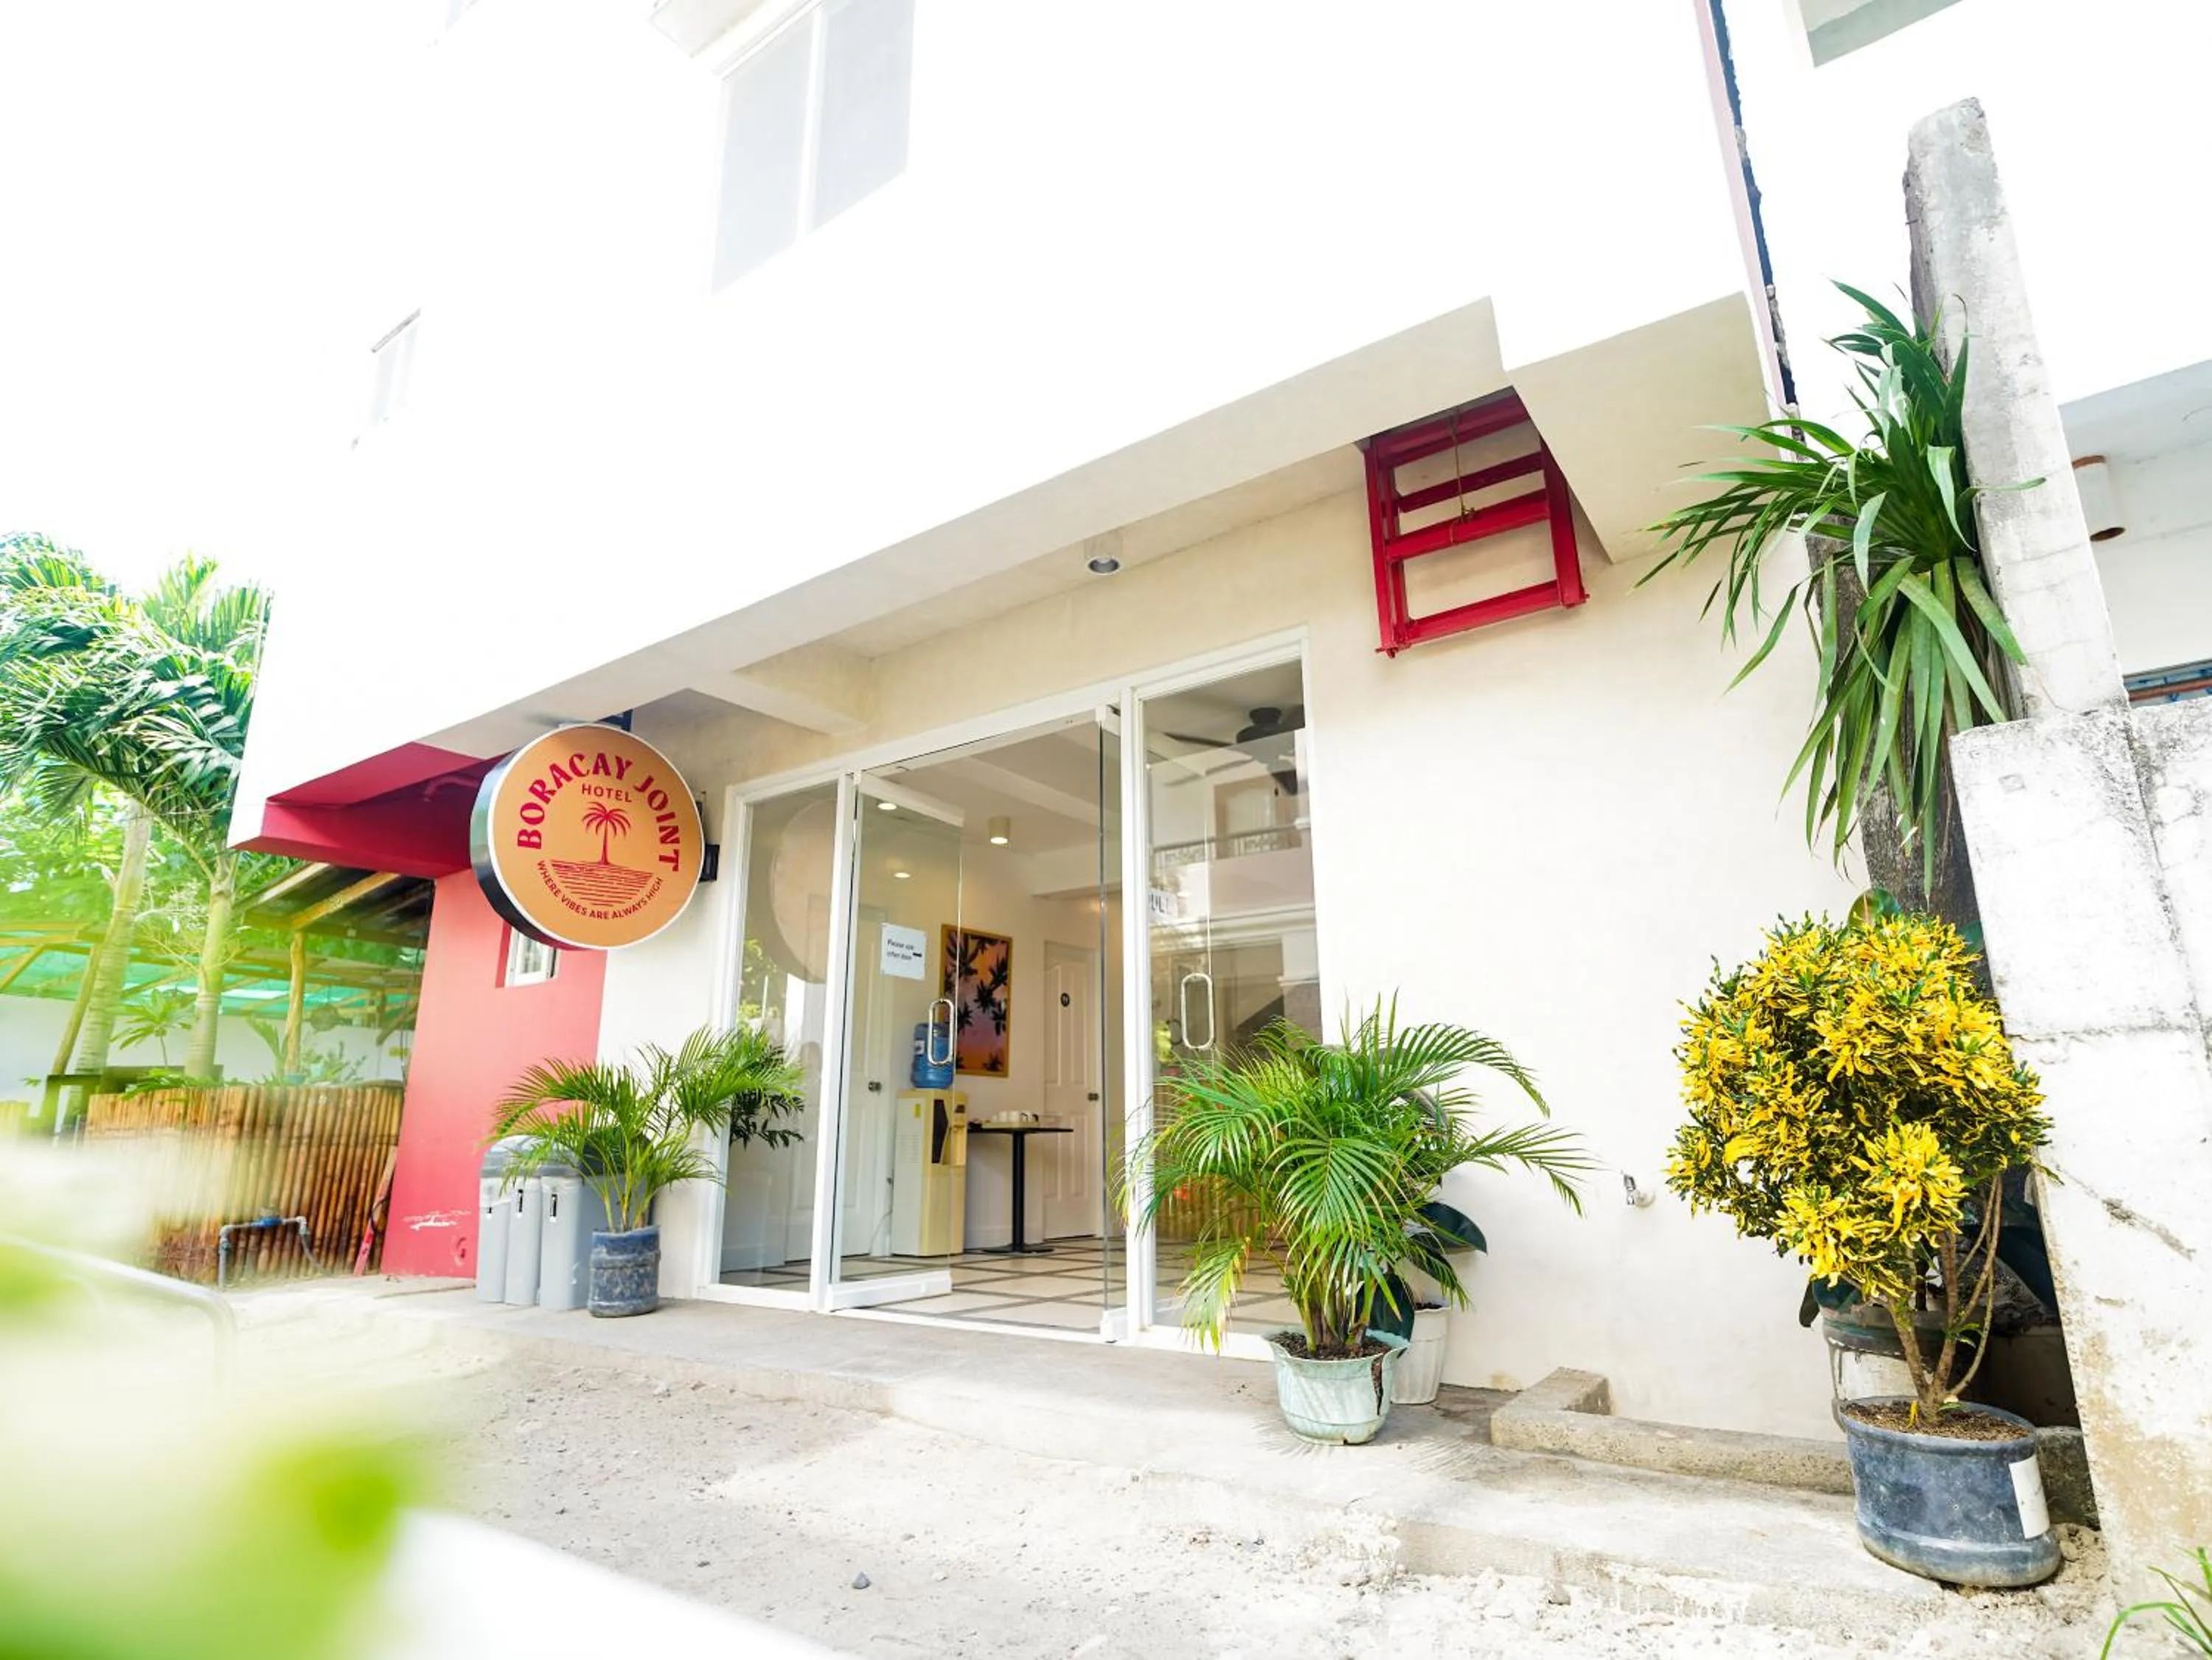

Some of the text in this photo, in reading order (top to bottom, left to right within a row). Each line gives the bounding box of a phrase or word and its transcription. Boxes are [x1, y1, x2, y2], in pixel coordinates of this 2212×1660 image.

[517, 753, 681, 872] BORACAY JOINT
[581, 784, 633, 803] HOTEL
[537, 859, 663, 920] WHERE VIBES ARE ALWAYS HIGH
